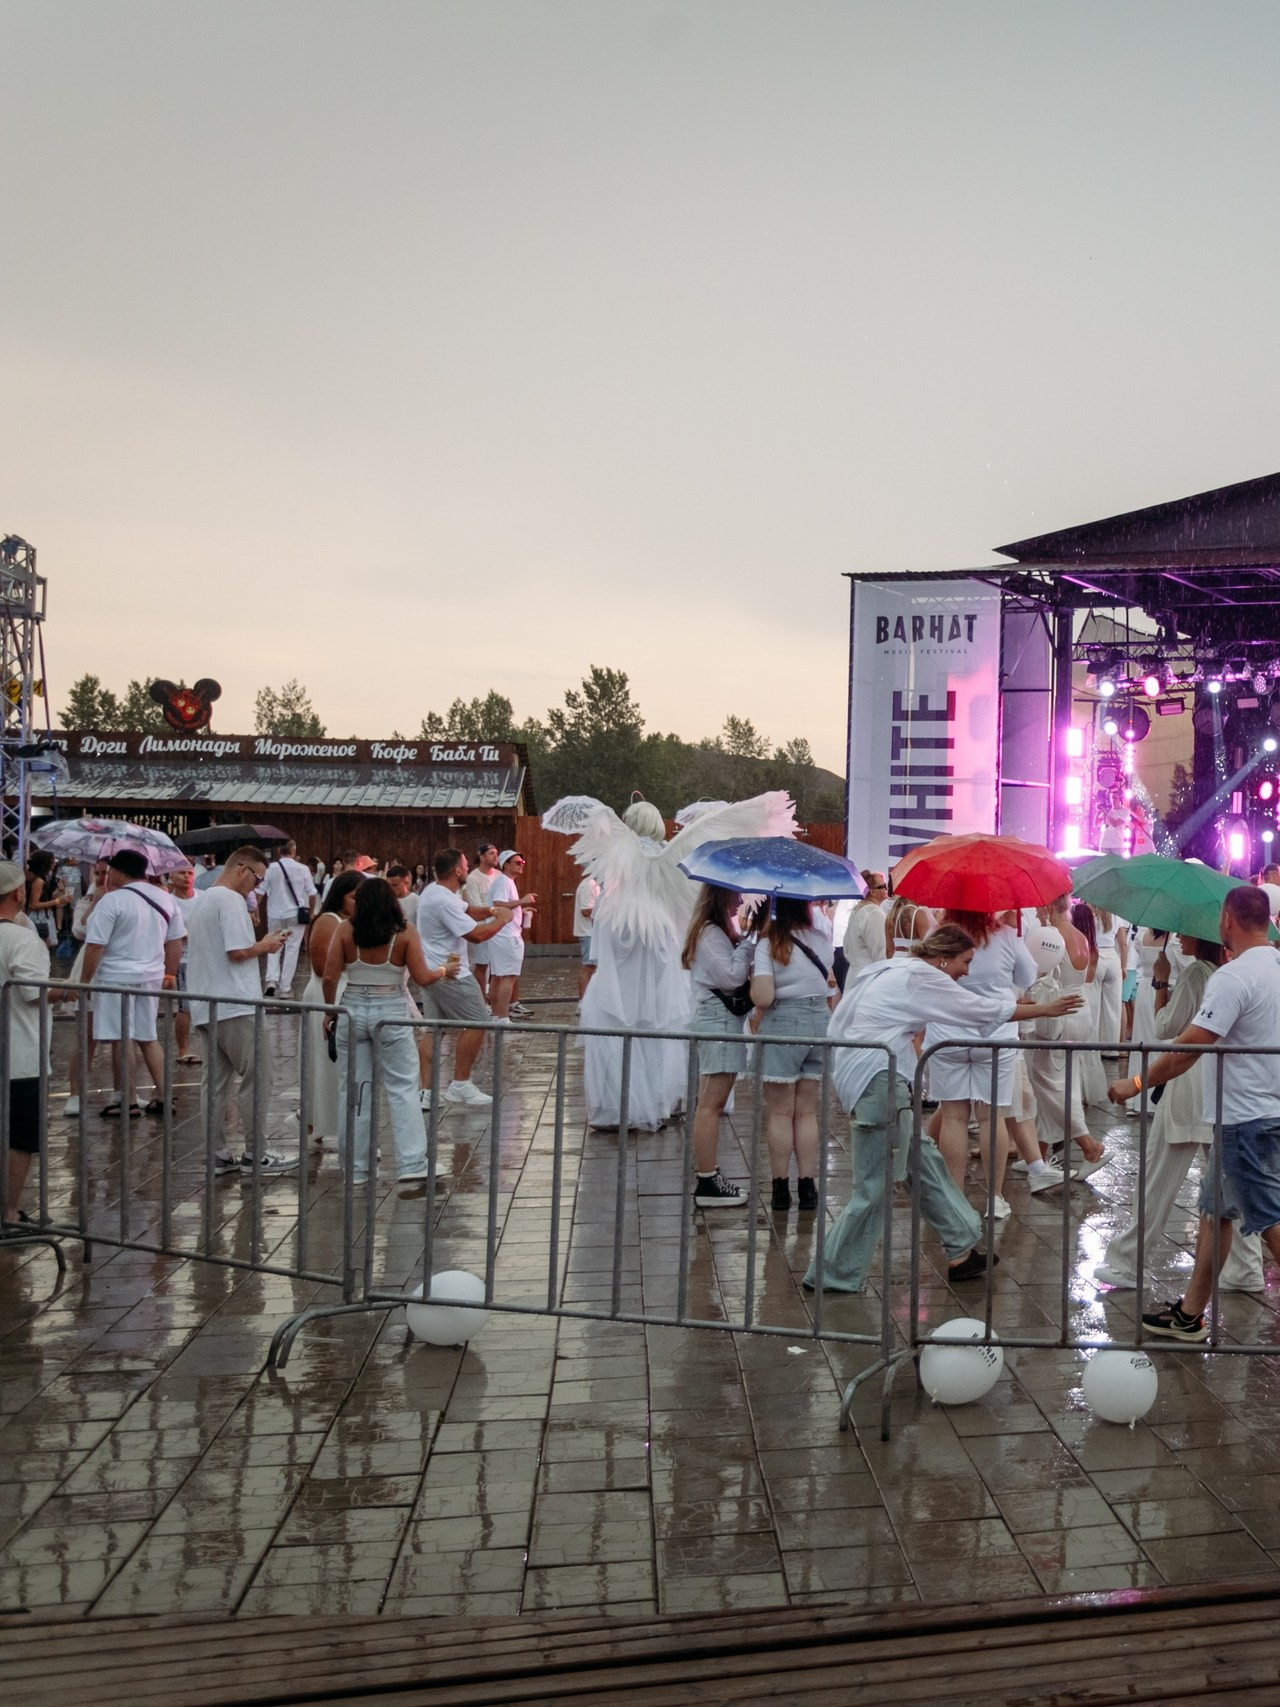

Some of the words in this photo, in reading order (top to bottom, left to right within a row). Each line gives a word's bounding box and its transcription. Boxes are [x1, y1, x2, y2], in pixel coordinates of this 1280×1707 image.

[875, 614, 978, 644] BARHAT
[80, 735, 128, 754] Доги
[138, 735, 241, 758] Лимонады
[254, 738, 357, 760] Мороженое
[370, 742, 418, 763] Кофе
[429, 745, 476, 762] Бабл
[479, 745, 500, 762] Ти
